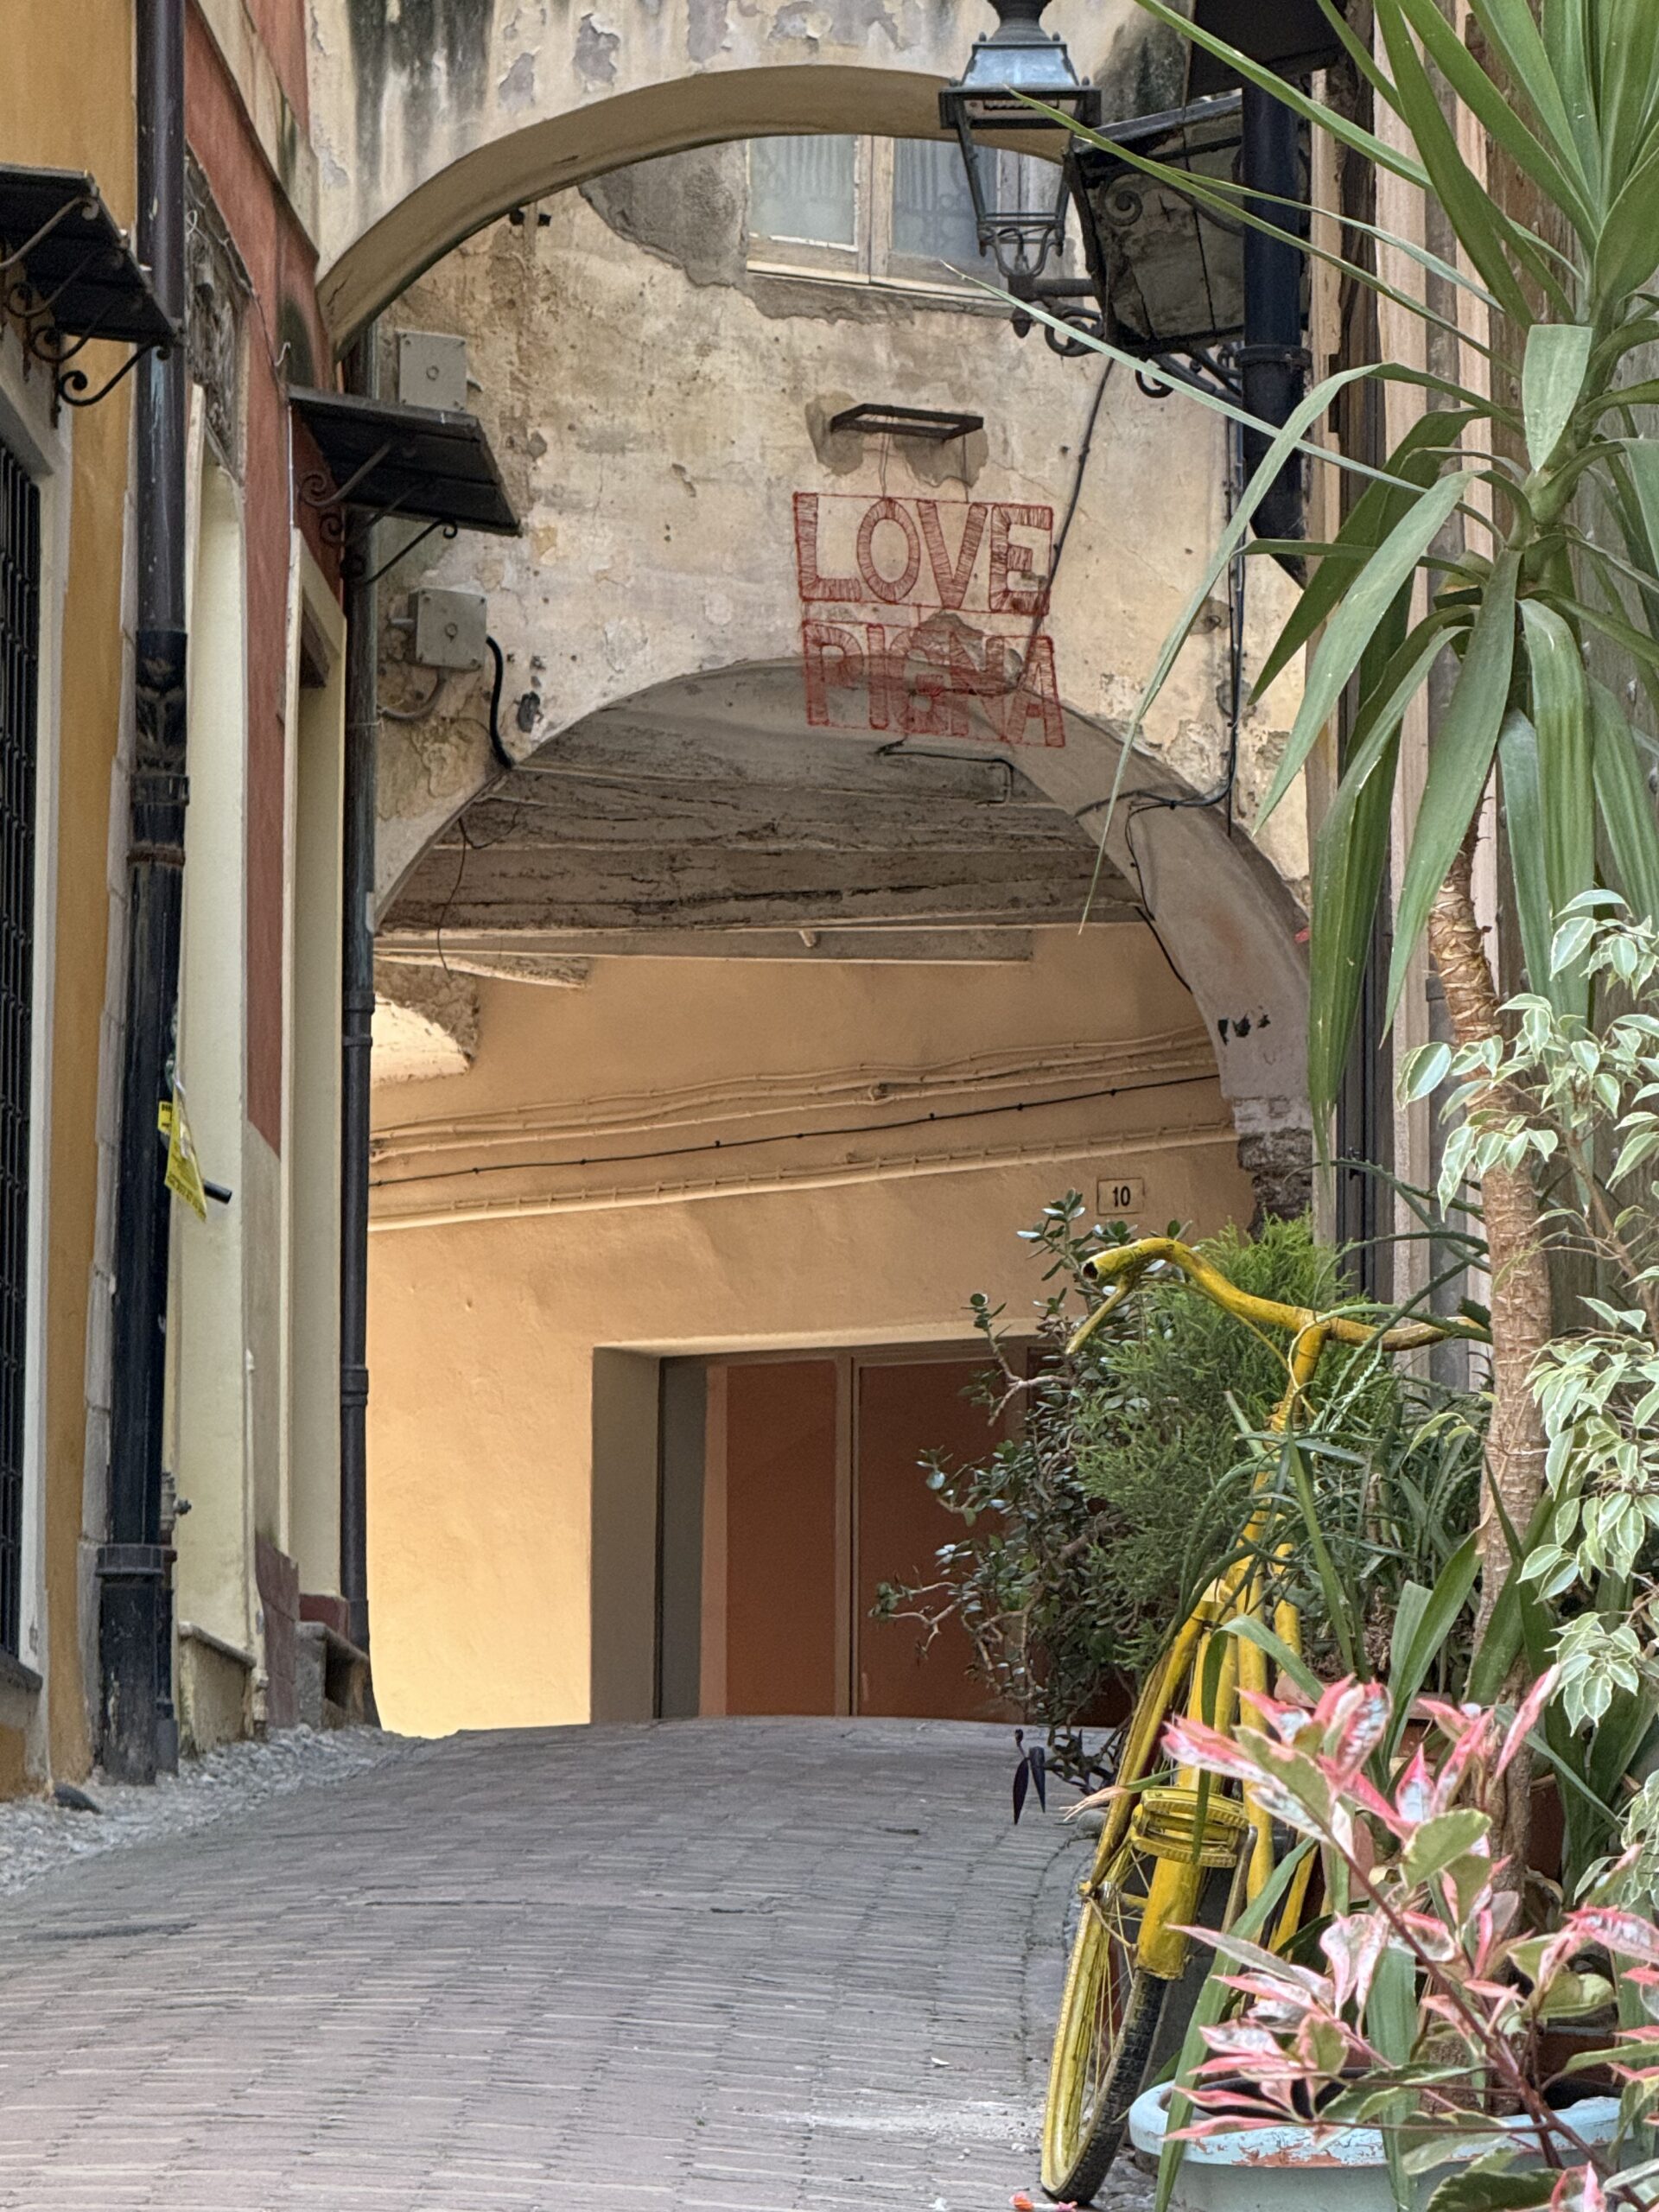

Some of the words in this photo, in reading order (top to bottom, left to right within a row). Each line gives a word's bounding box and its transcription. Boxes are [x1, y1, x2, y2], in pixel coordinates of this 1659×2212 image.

[793, 491, 1054, 617] LOVE
[802, 620, 1066, 747] PIGNA
[1112, 1185, 1131, 1208] 10
